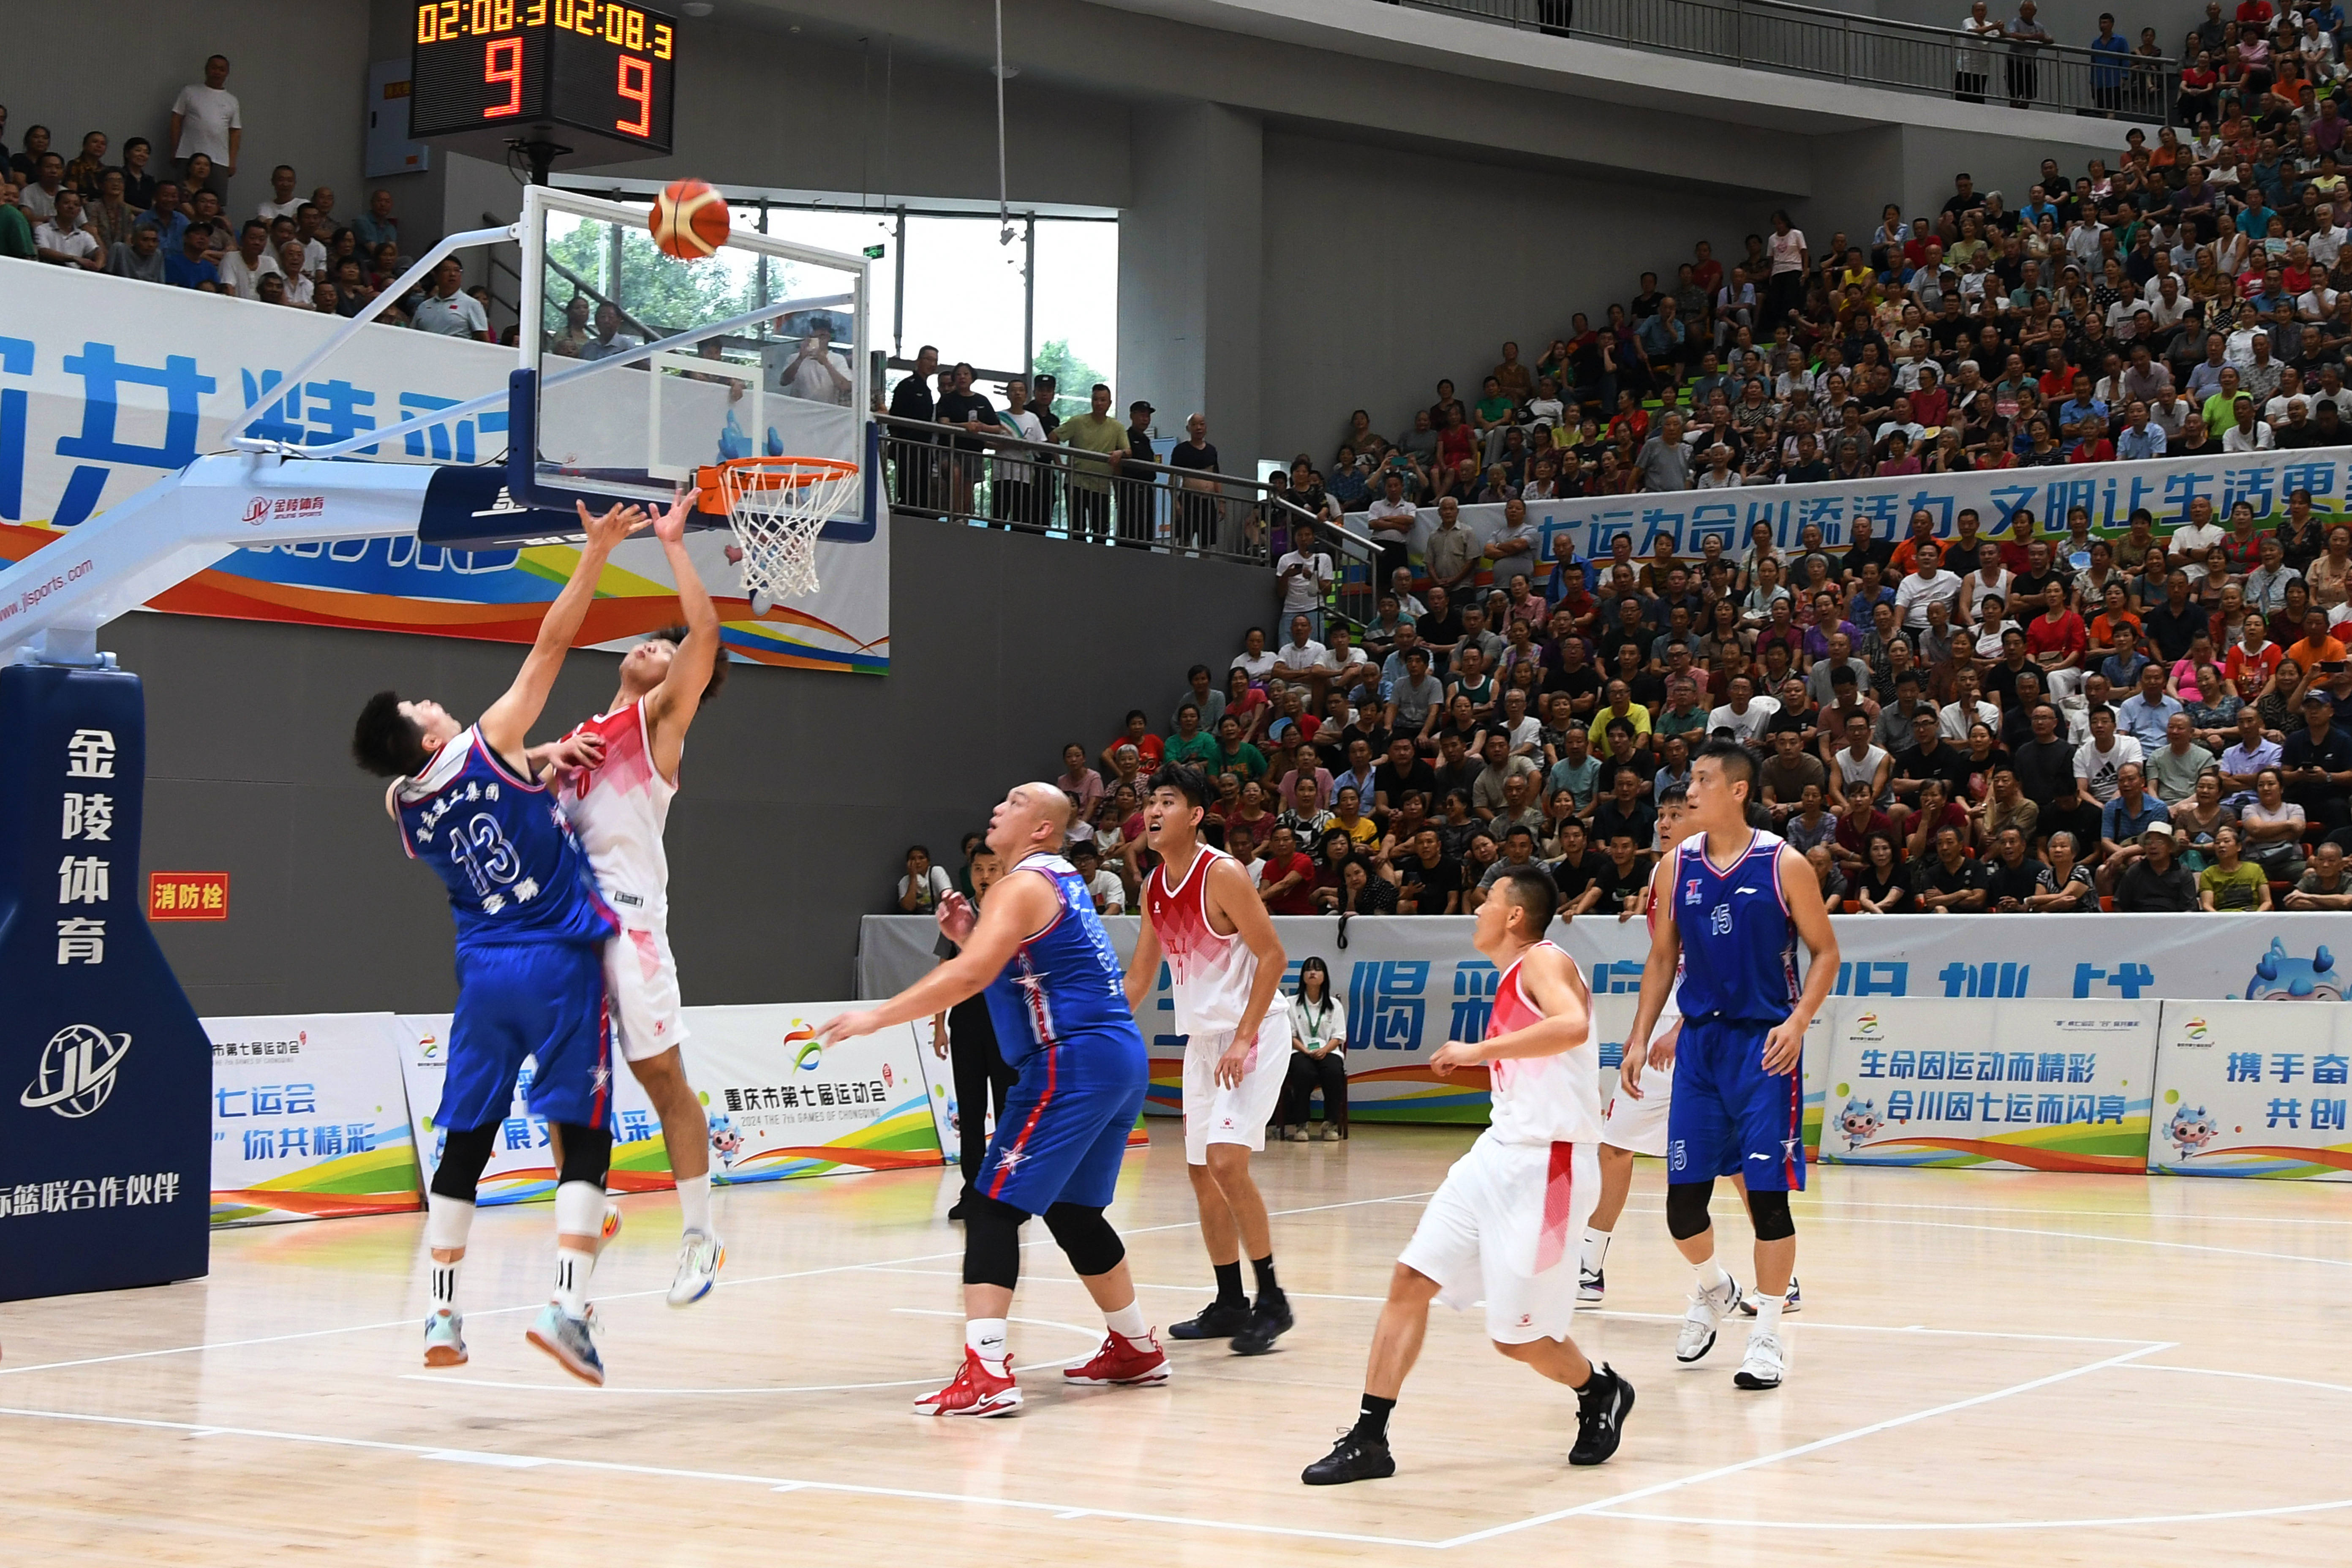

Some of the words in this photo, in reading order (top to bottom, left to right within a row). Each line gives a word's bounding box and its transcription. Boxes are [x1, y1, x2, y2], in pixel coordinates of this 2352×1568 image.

[418, 0, 546, 43] 02:08.3
[555, 0, 672, 60] 02:08.3
[484, 37, 523, 117] 9
[616, 55, 652, 136] 9
[274, 496, 324, 512] 金陵体育
[1988, 462, 2352, 536] 文明让生活更
[57, 729, 116, 965] 金陵体育
[449, 812, 520, 896] 13
[155, 883, 223, 910] 消防栓
[1711, 904, 1732, 935] 15
[1859, 1049, 2097, 1083] 生命因运动而精彩
[2226, 1051, 2350, 1084] 携手奋
[215, 1083, 316, 1119] 七运会
[724, 1080, 886, 1111] 重庆市第七届运动会
[1886, 1089, 2126, 1125] 合川因七运而闪亮
[741, 1116, 761, 1127] 2024
[764, 1114, 779, 1125] THE
[798, 1111, 824, 1123] GAMES
[2265, 1097, 2347, 1130] 共创
[1668, 1140, 1688, 1171] 15
